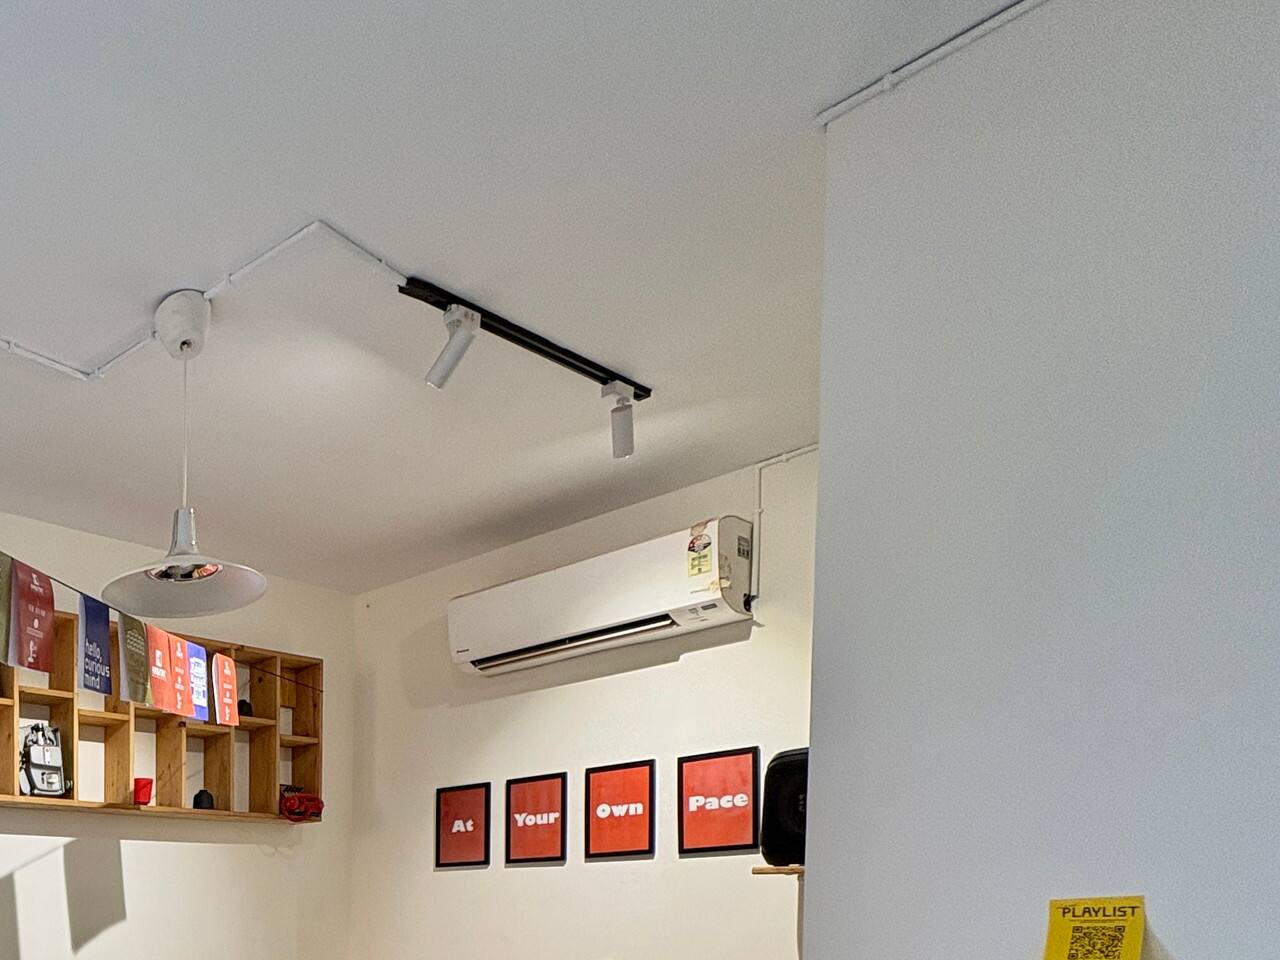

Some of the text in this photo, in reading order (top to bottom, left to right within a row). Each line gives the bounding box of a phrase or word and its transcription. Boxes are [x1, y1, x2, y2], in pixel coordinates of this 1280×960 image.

[688, 793, 748, 811] Pace
[596, 803, 643, 818] Own
[451, 819, 474, 832] At
[513, 812, 559, 827] Your
[1057, 906, 1140, 918] PLAYLIST
